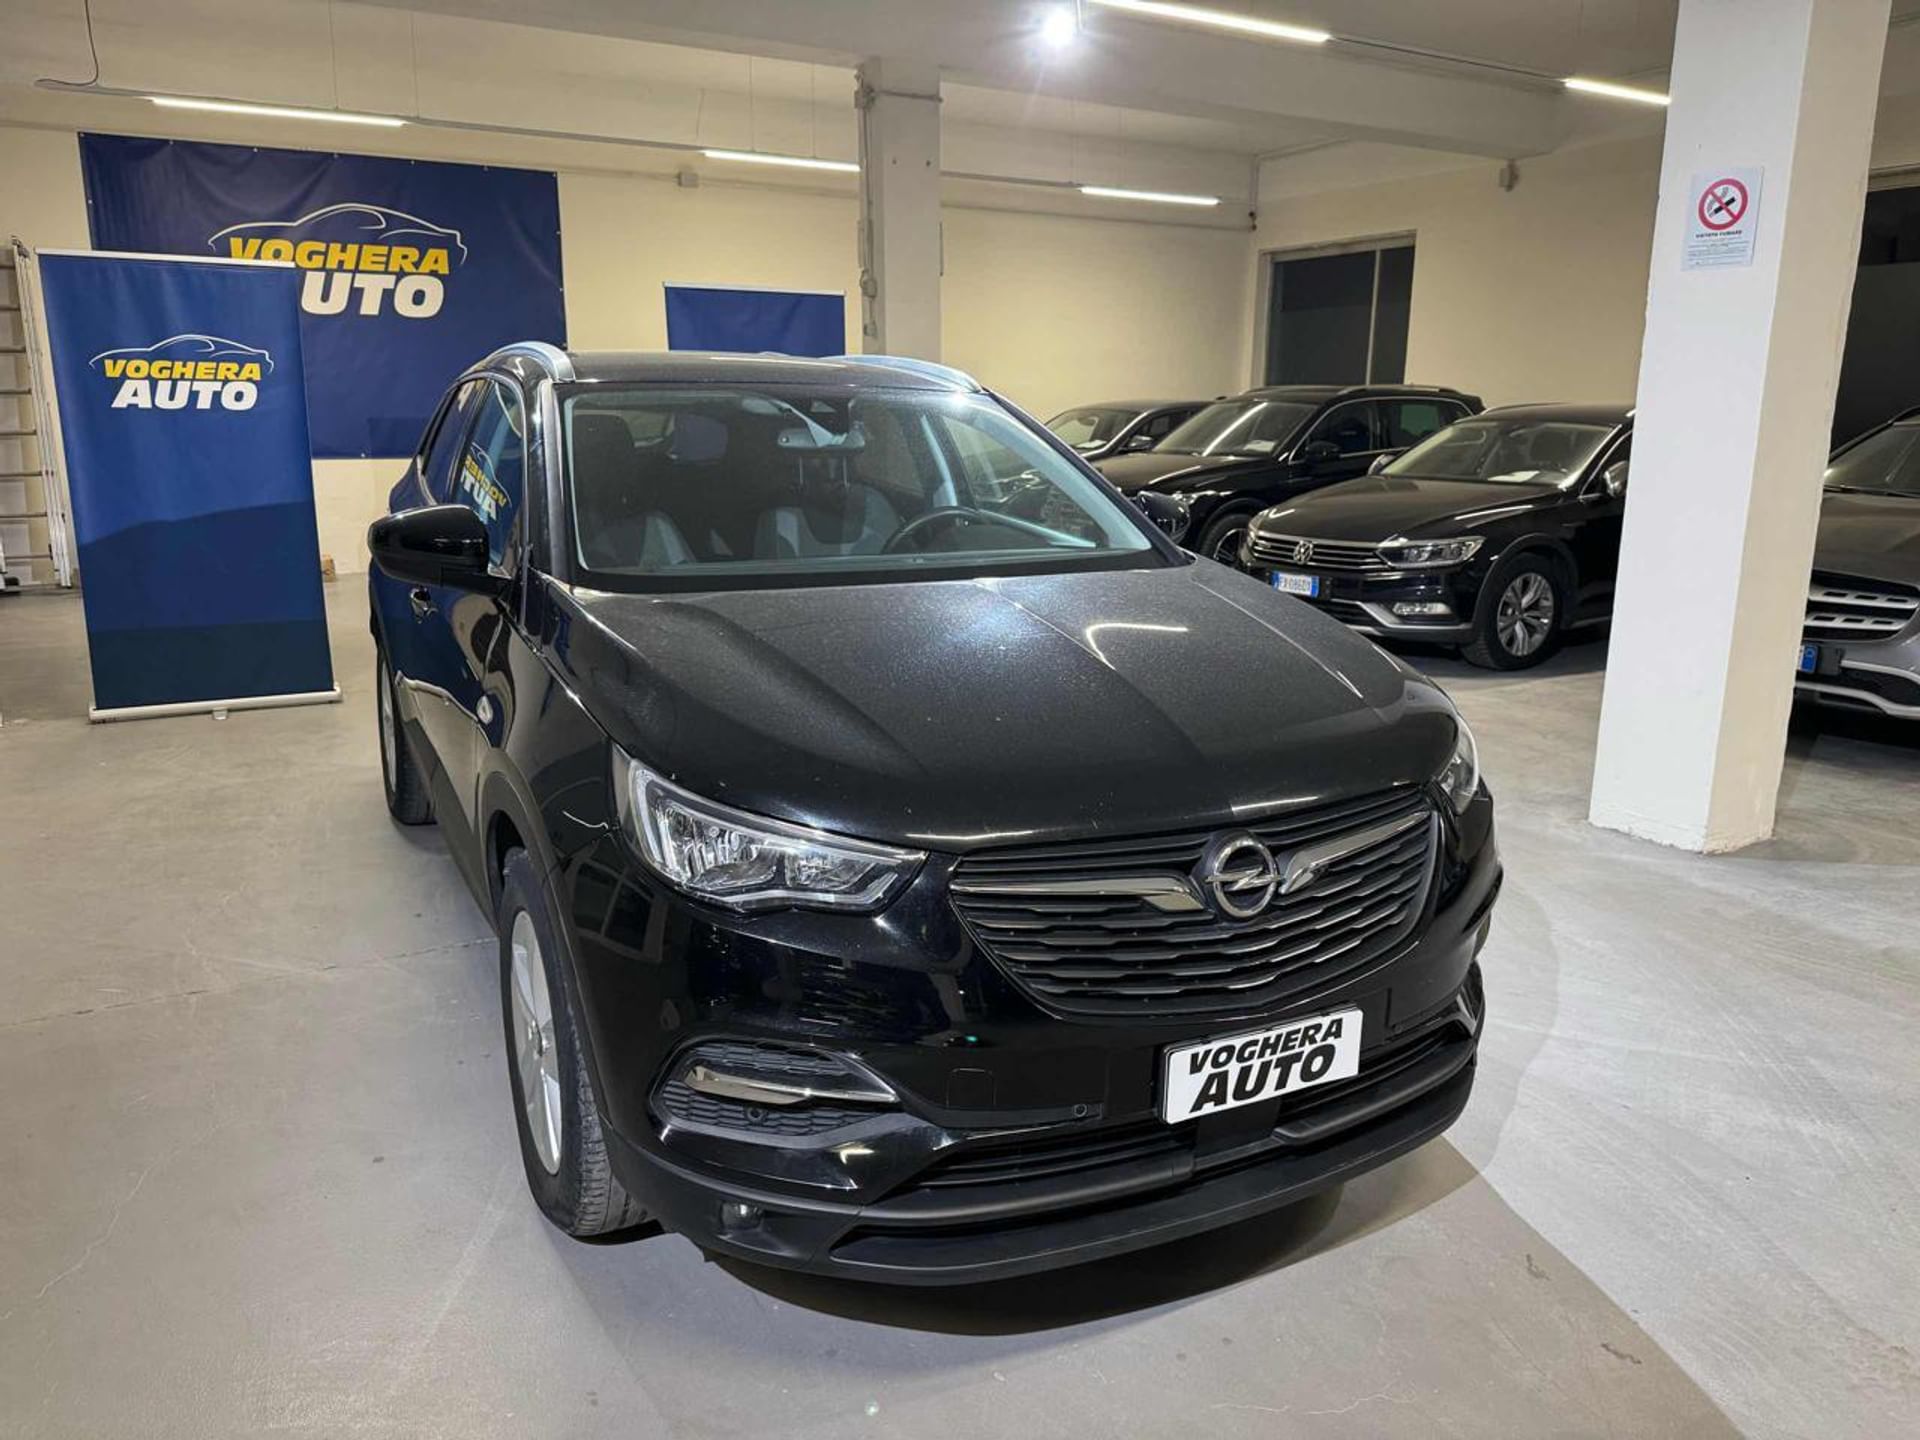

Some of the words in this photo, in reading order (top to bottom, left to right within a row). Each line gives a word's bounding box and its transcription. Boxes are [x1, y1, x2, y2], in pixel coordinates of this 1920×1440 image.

[229, 237, 450, 275] VOGHERA
[301, 271, 445, 319] UTO
[103, 358, 262, 381] VOGHERA
[111, 379, 259, 411] AUTO
[1189, 1017, 1344, 1075] VOGHERA
[1189, 1043, 1337, 1114] AUTO
